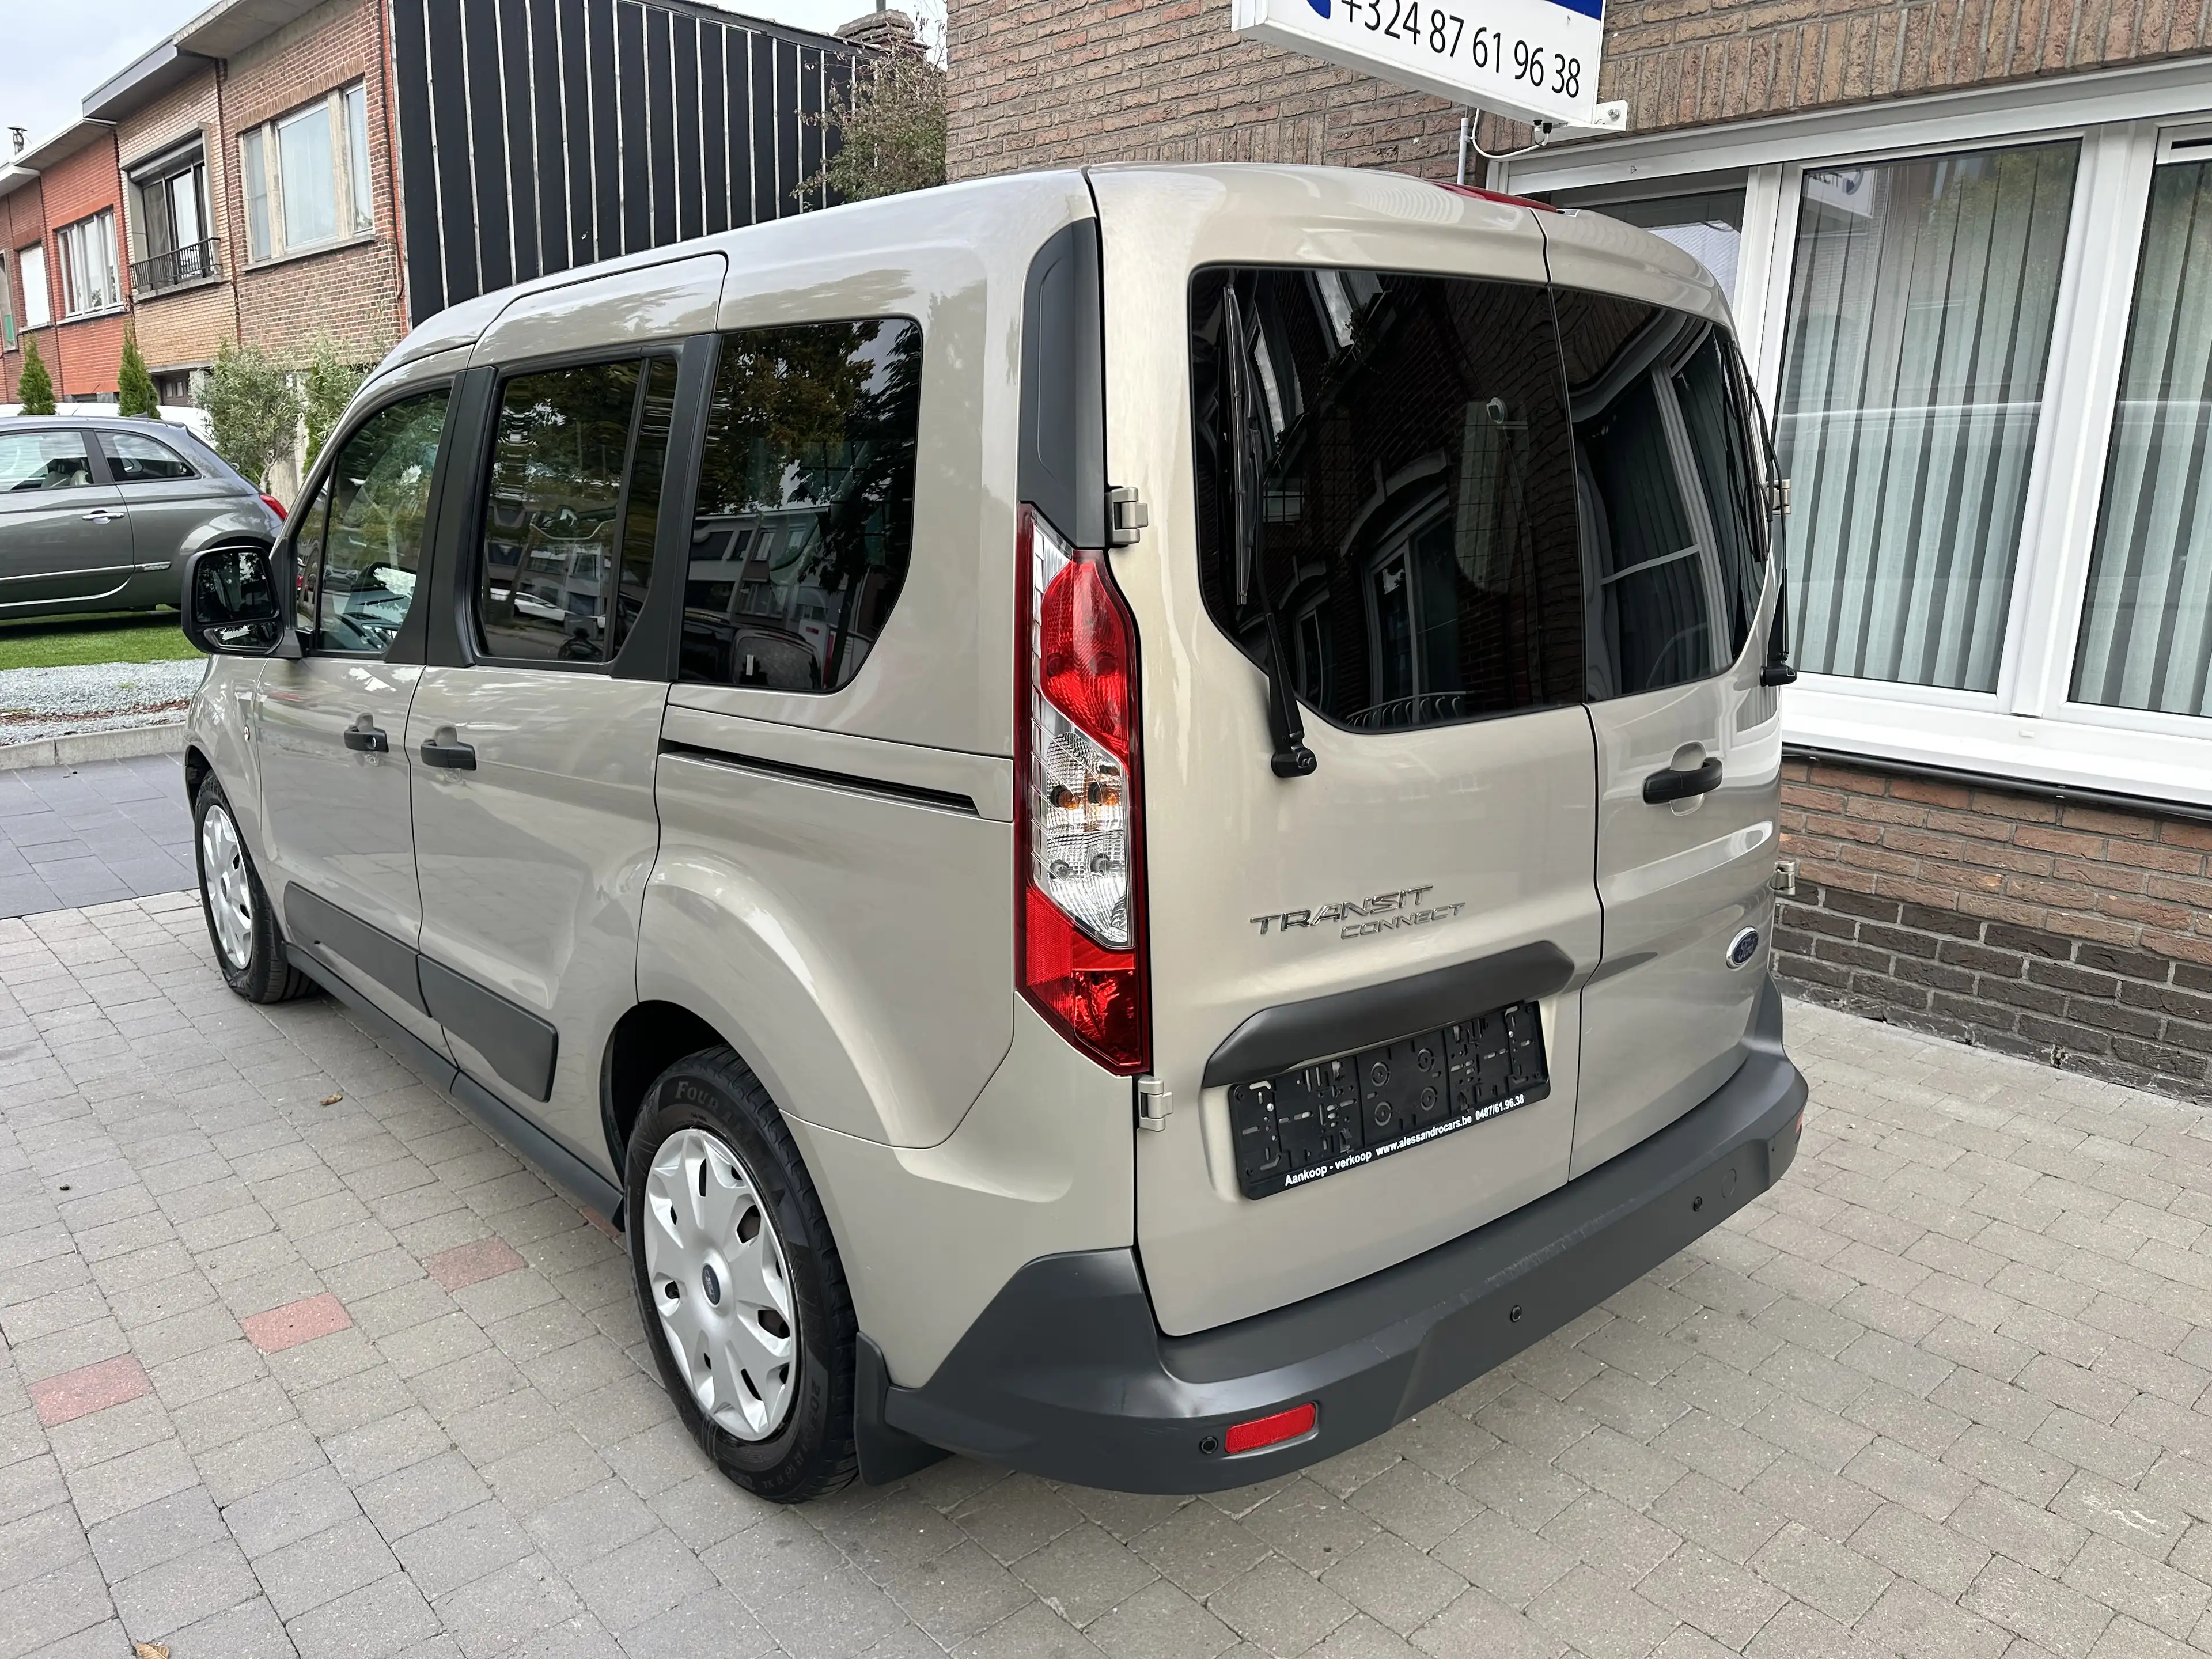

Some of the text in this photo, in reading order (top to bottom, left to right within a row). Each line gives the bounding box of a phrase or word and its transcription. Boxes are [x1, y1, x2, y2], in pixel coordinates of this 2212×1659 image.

[1341, 0, 1580, 98] +324 87 61 96 38
[1249, 884, 1434, 934] TRANSIT
[1341, 902, 1466, 940] CONNECT
[1285, 1165, 1327, 1187] Aankoop
[1335, 1150, 1372, 1169] verkoop
[1376, 1114, 1472, 1156] www.alessandrocars.be
[1475, 1094, 1525, 1120] 0487/61.96.38
